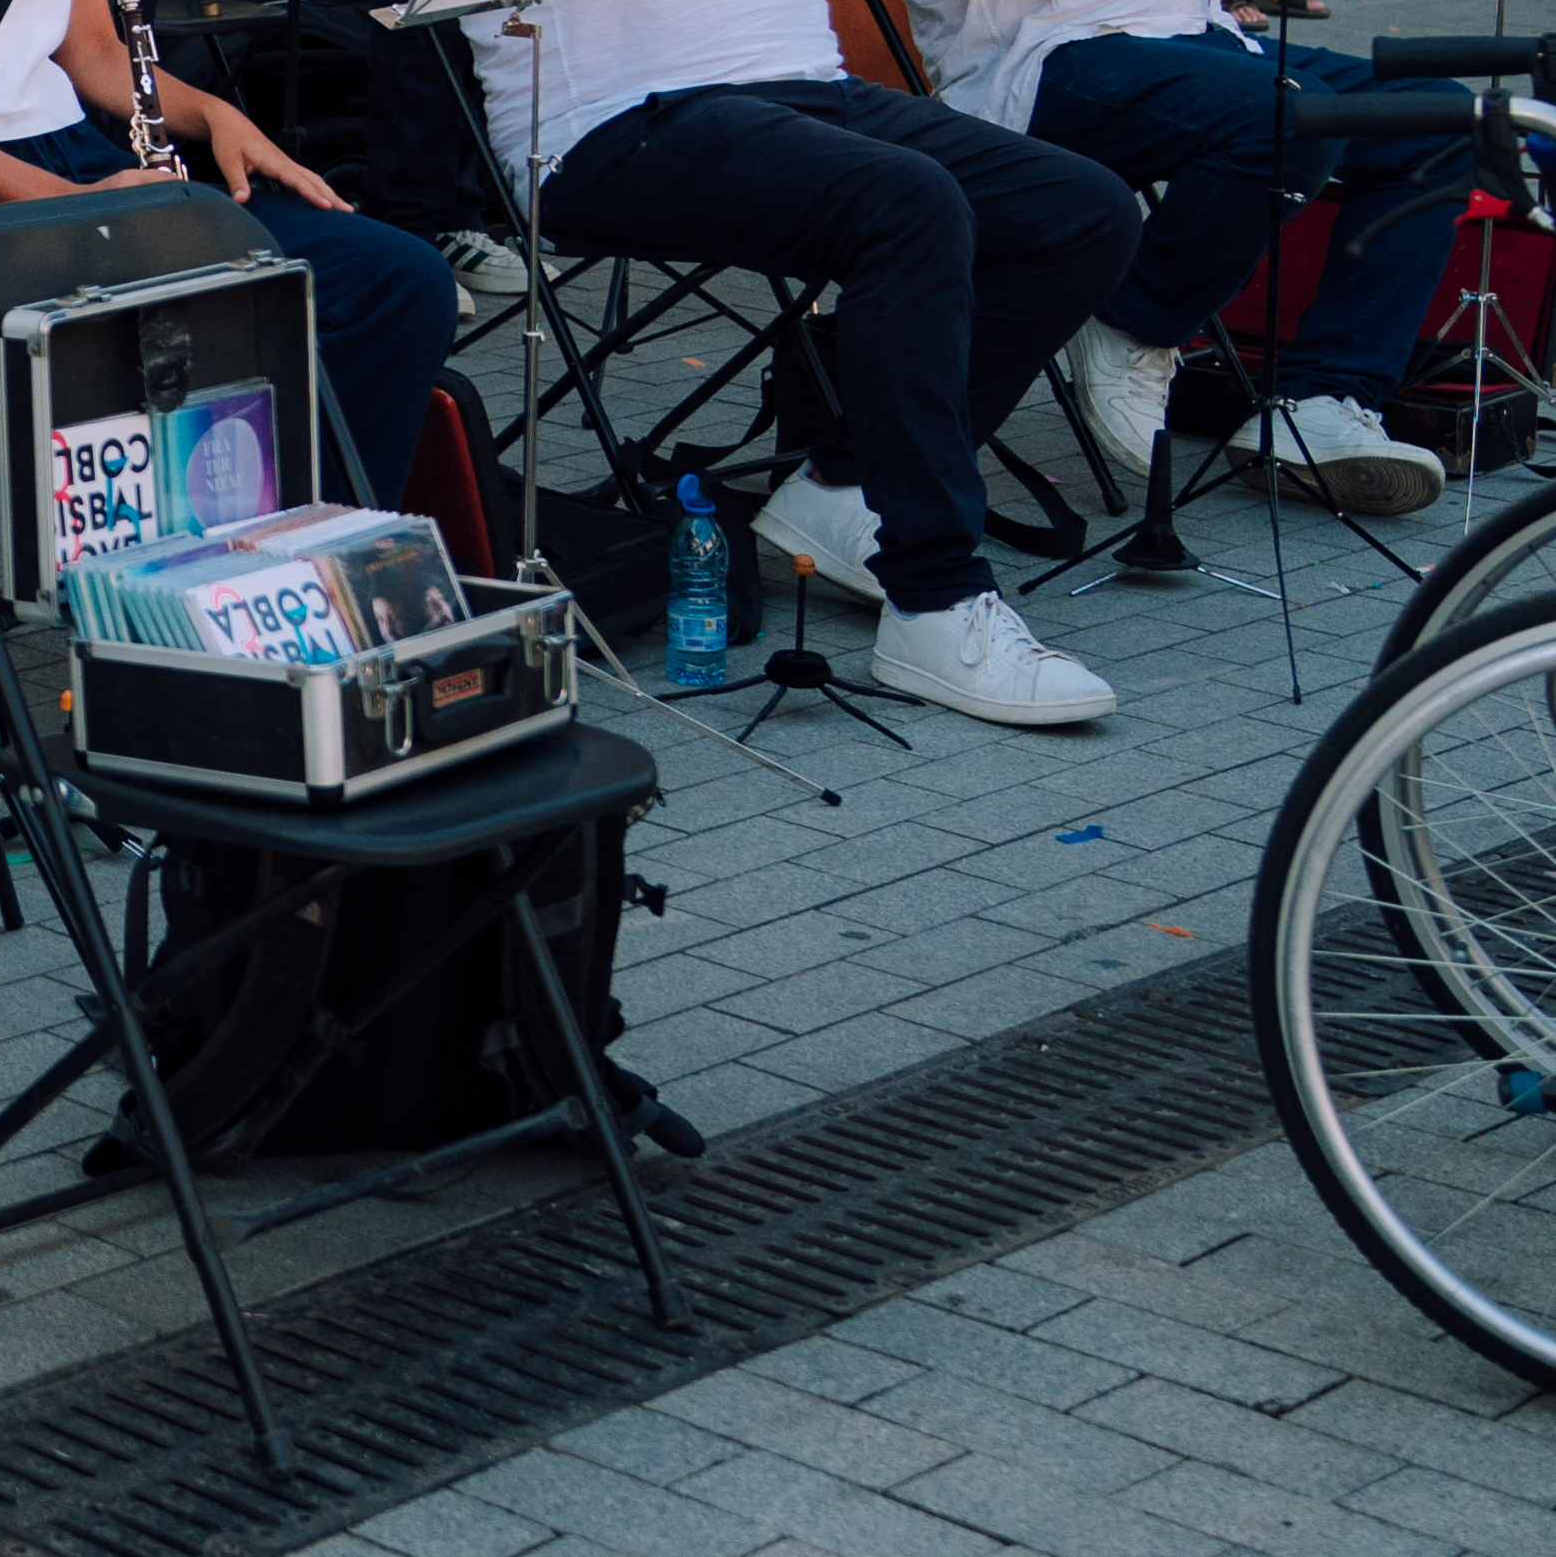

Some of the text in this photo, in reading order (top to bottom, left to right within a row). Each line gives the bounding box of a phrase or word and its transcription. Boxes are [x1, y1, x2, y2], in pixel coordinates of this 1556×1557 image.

[55, 434, 150, 485] COBL
[203, 437, 232, 457] FRA
[204, 456, 231, 475] TER
[54, 482, 152, 538] ISBAL
[204, 580, 330, 644] COBLA
